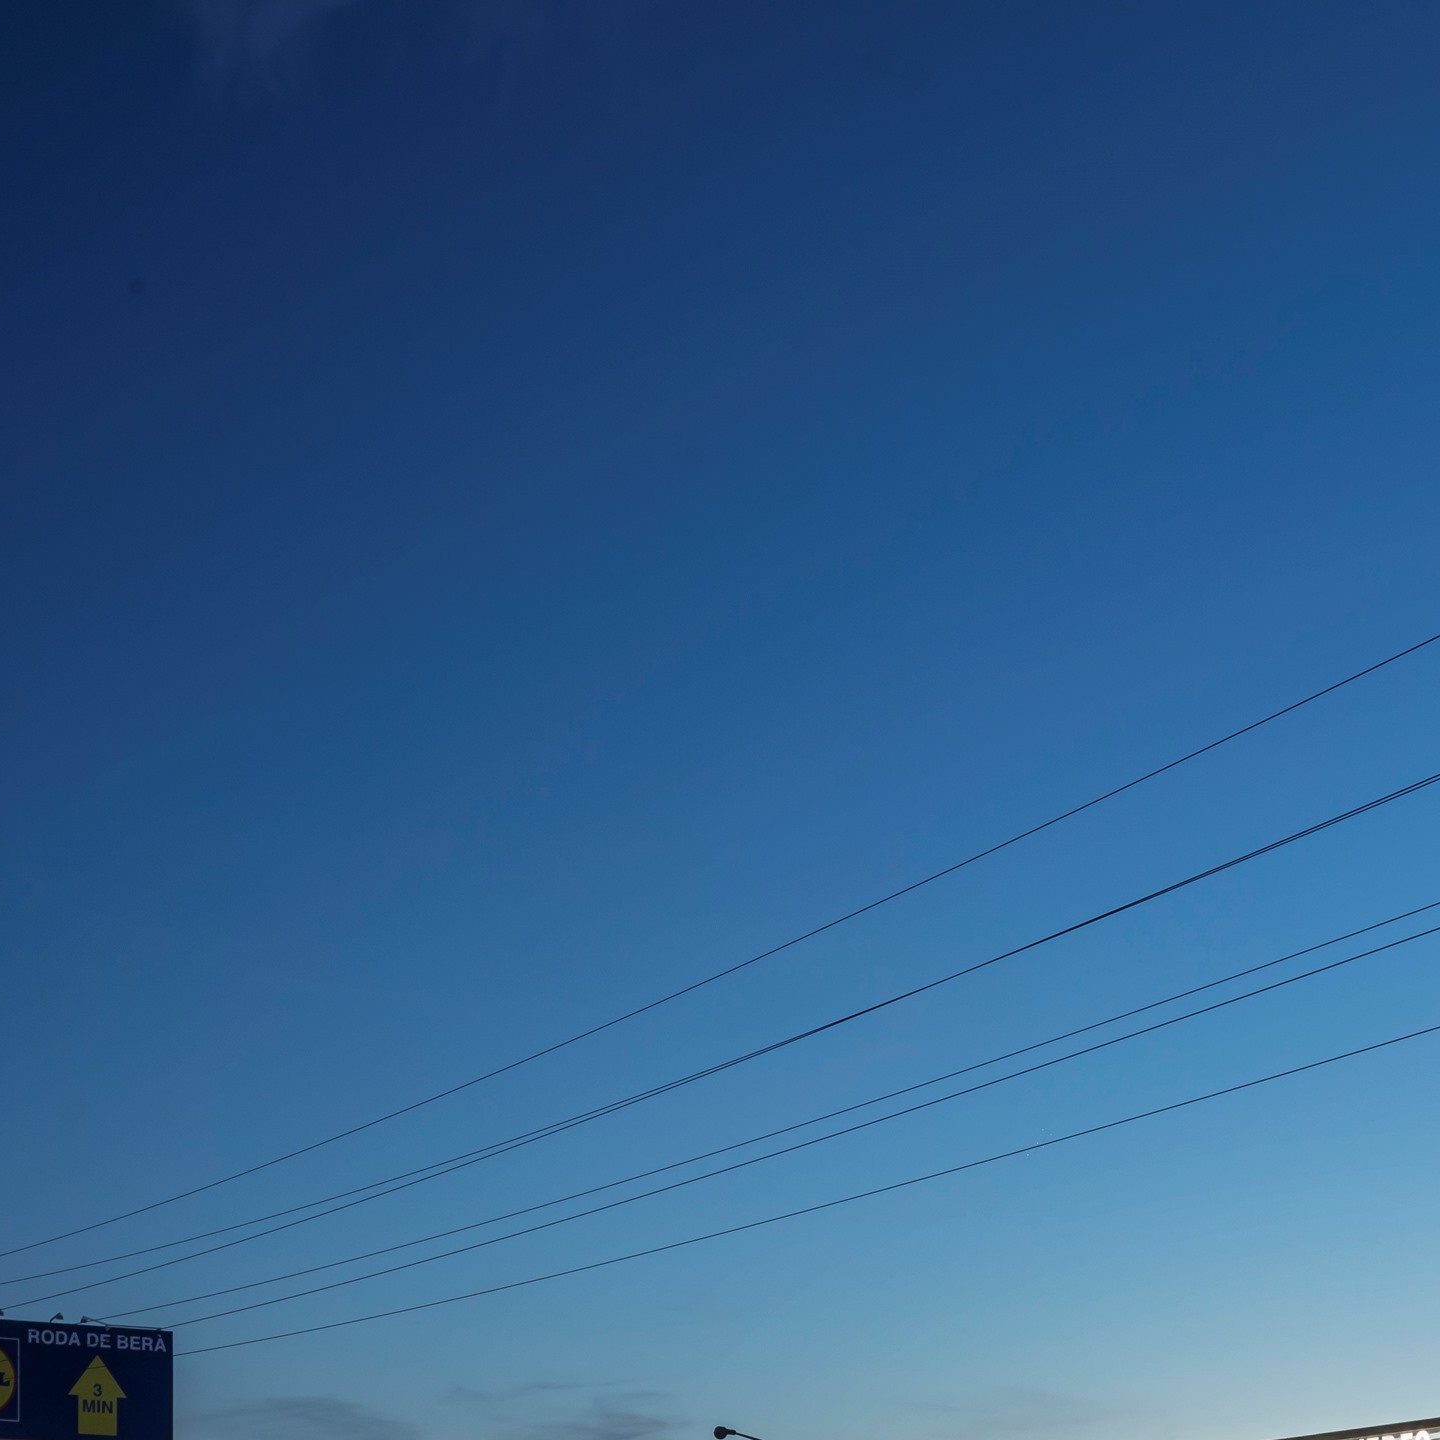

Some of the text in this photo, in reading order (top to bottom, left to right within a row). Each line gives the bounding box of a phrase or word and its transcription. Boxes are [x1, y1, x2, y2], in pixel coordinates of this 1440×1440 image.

[28, 1329, 81, 1346] RODA
[87, 1332, 111, 1349] DE
[92, 1383, 103, 1397] 3
[82, 1400, 114, 1415] MIN
